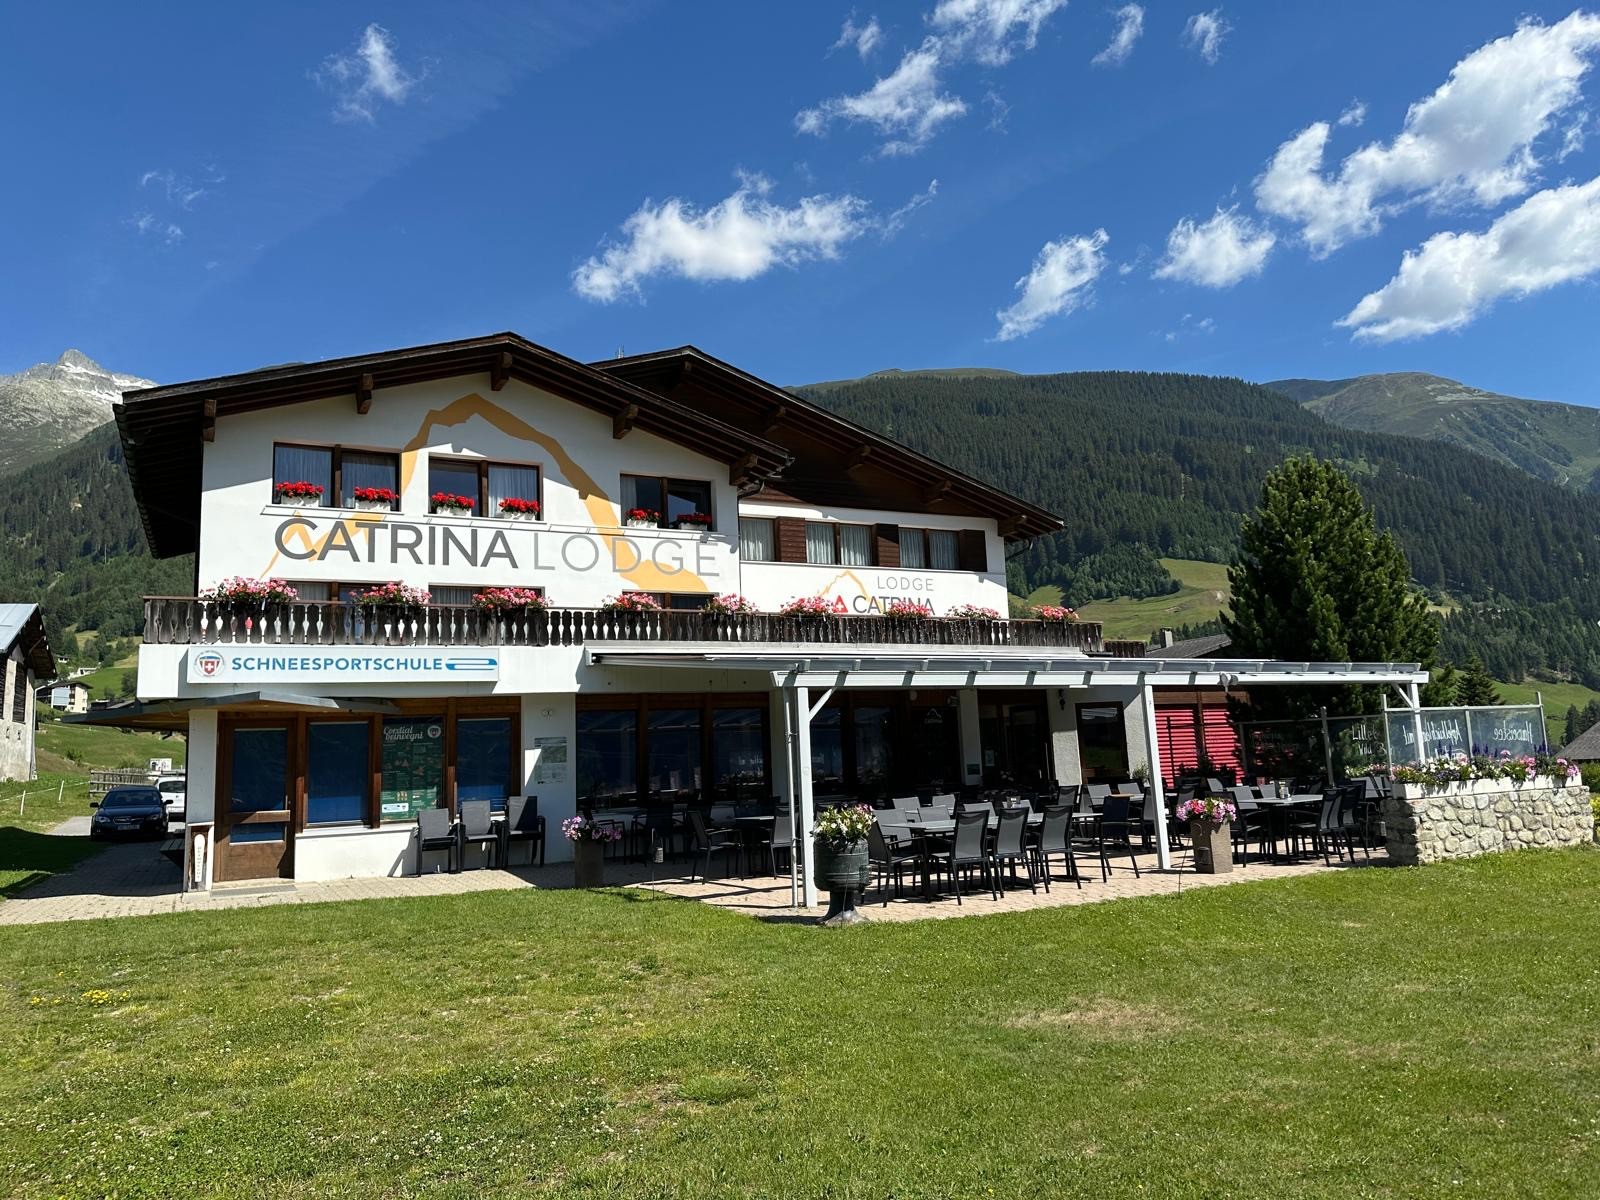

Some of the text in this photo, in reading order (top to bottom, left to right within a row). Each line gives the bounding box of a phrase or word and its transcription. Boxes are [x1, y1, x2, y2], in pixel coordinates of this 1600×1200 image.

[275, 517, 720, 577] CATRINA LODGE
[877, 575, 934, 591] LODGE
[232, 657, 442, 671] SCHNEESPORTSCHULE
